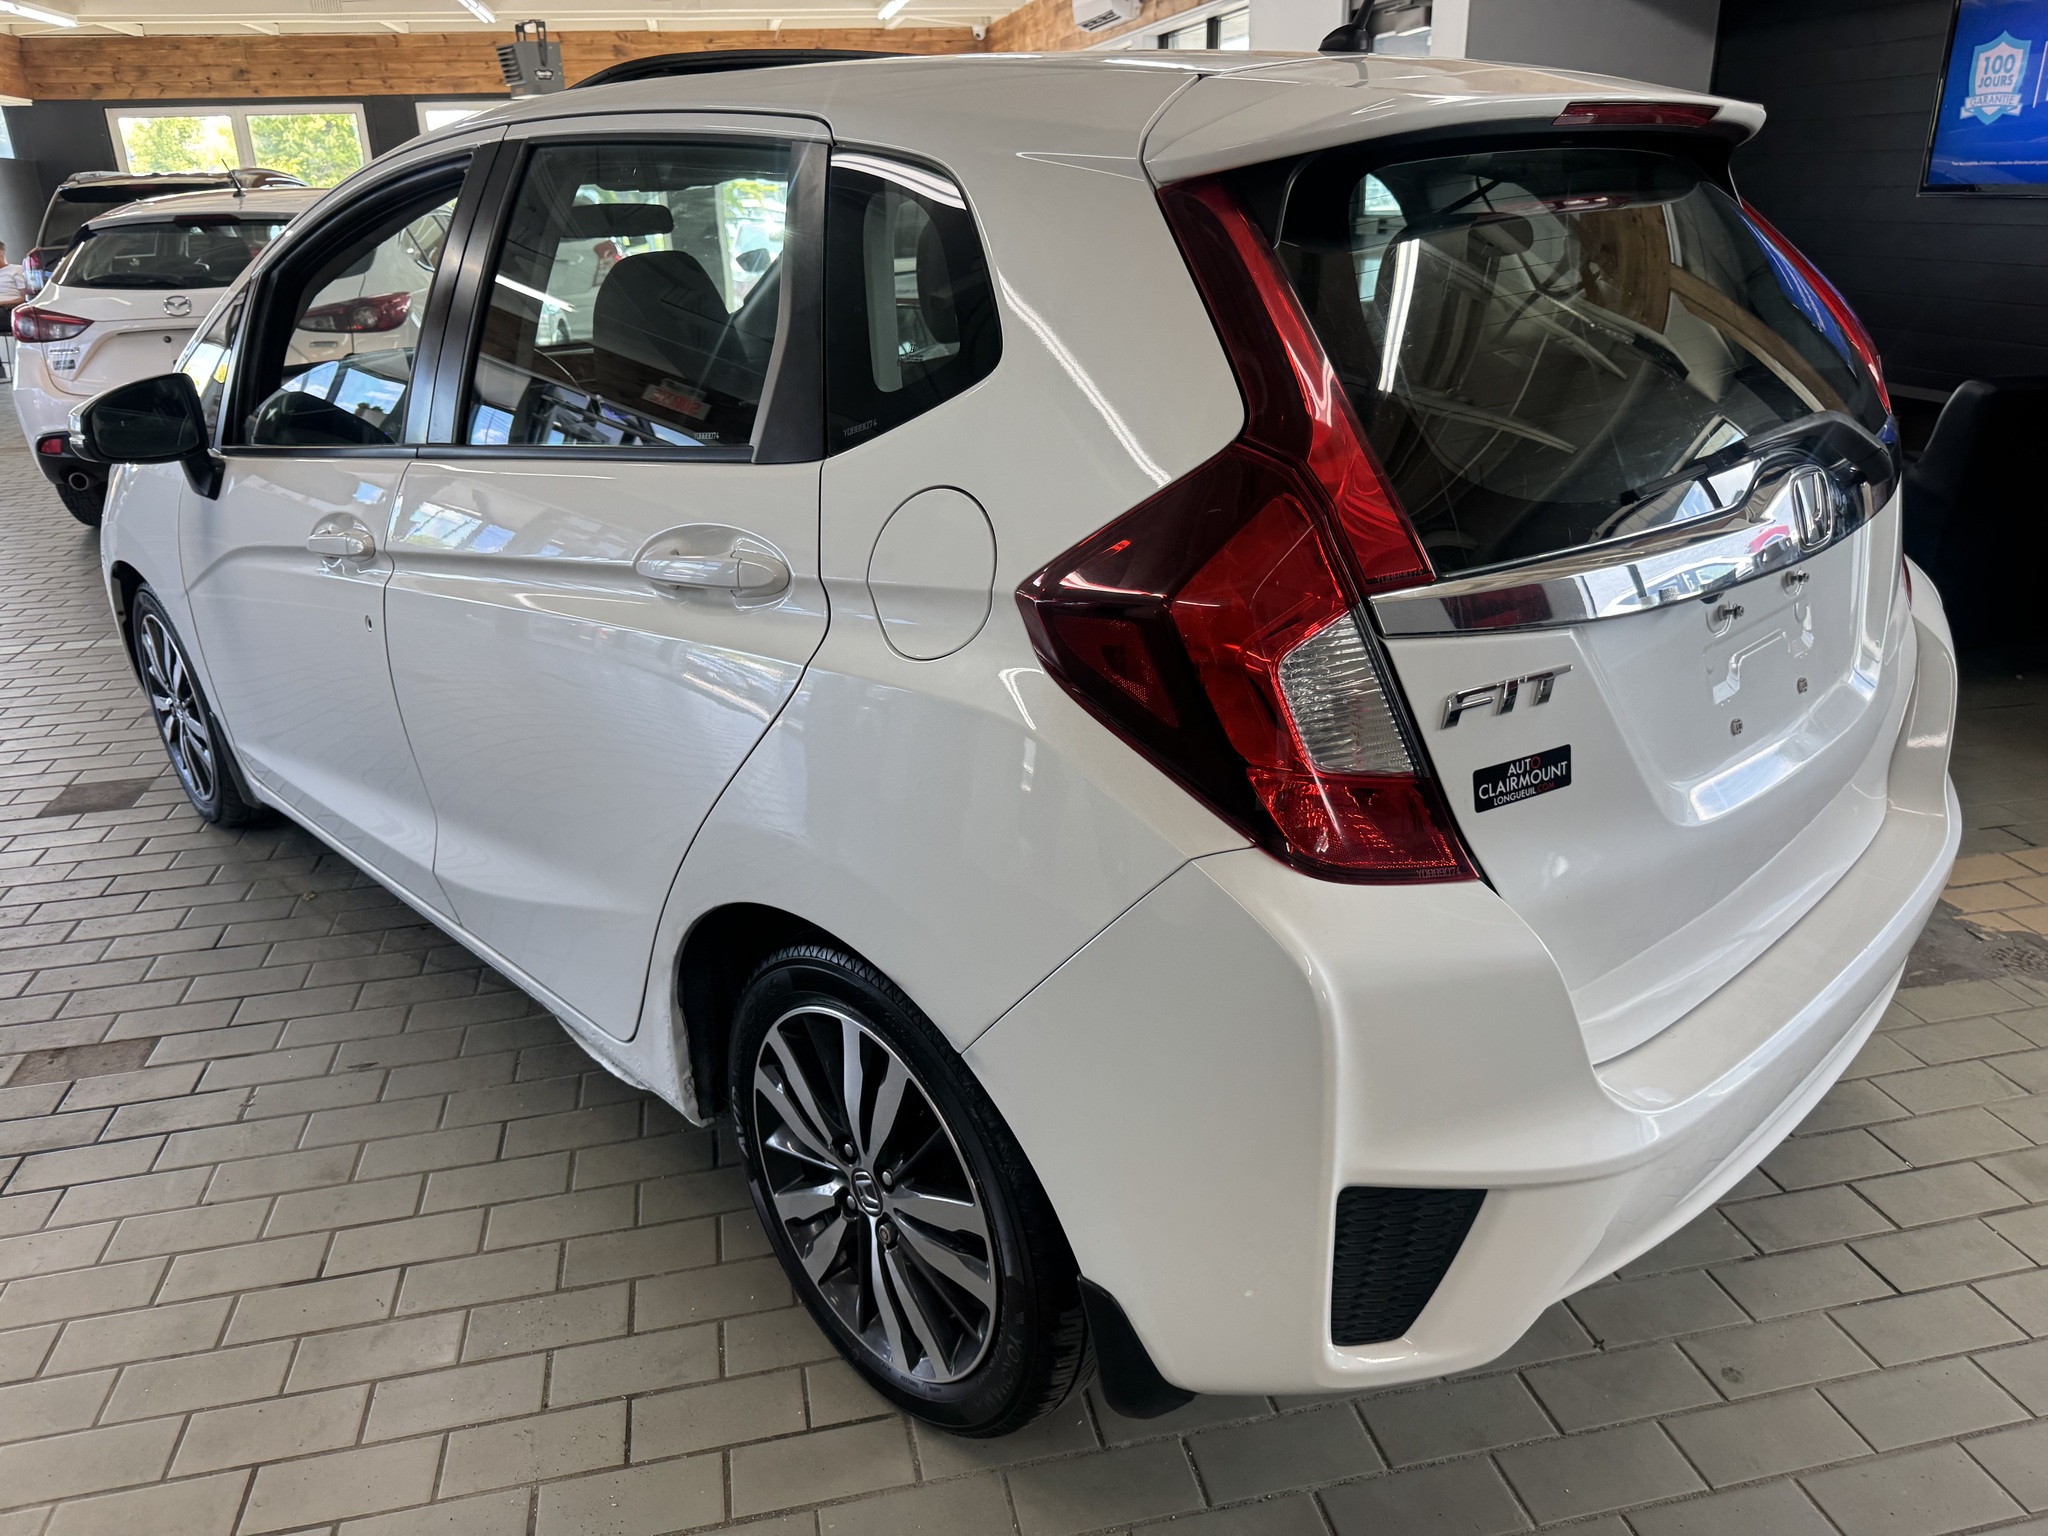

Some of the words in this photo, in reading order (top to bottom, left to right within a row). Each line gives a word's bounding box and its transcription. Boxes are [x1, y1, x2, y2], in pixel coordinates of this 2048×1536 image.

[1984, 54, 2016, 75] 100
[1978, 75, 2014, 88] JOURS
[1970, 94, 2015, 106] GARANTIE
[1441, 664, 1573, 730] FIT
[1507, 756, 1541, 777] AUTO
[1478, 761, 1568, 800] CLAIRMOUNT
